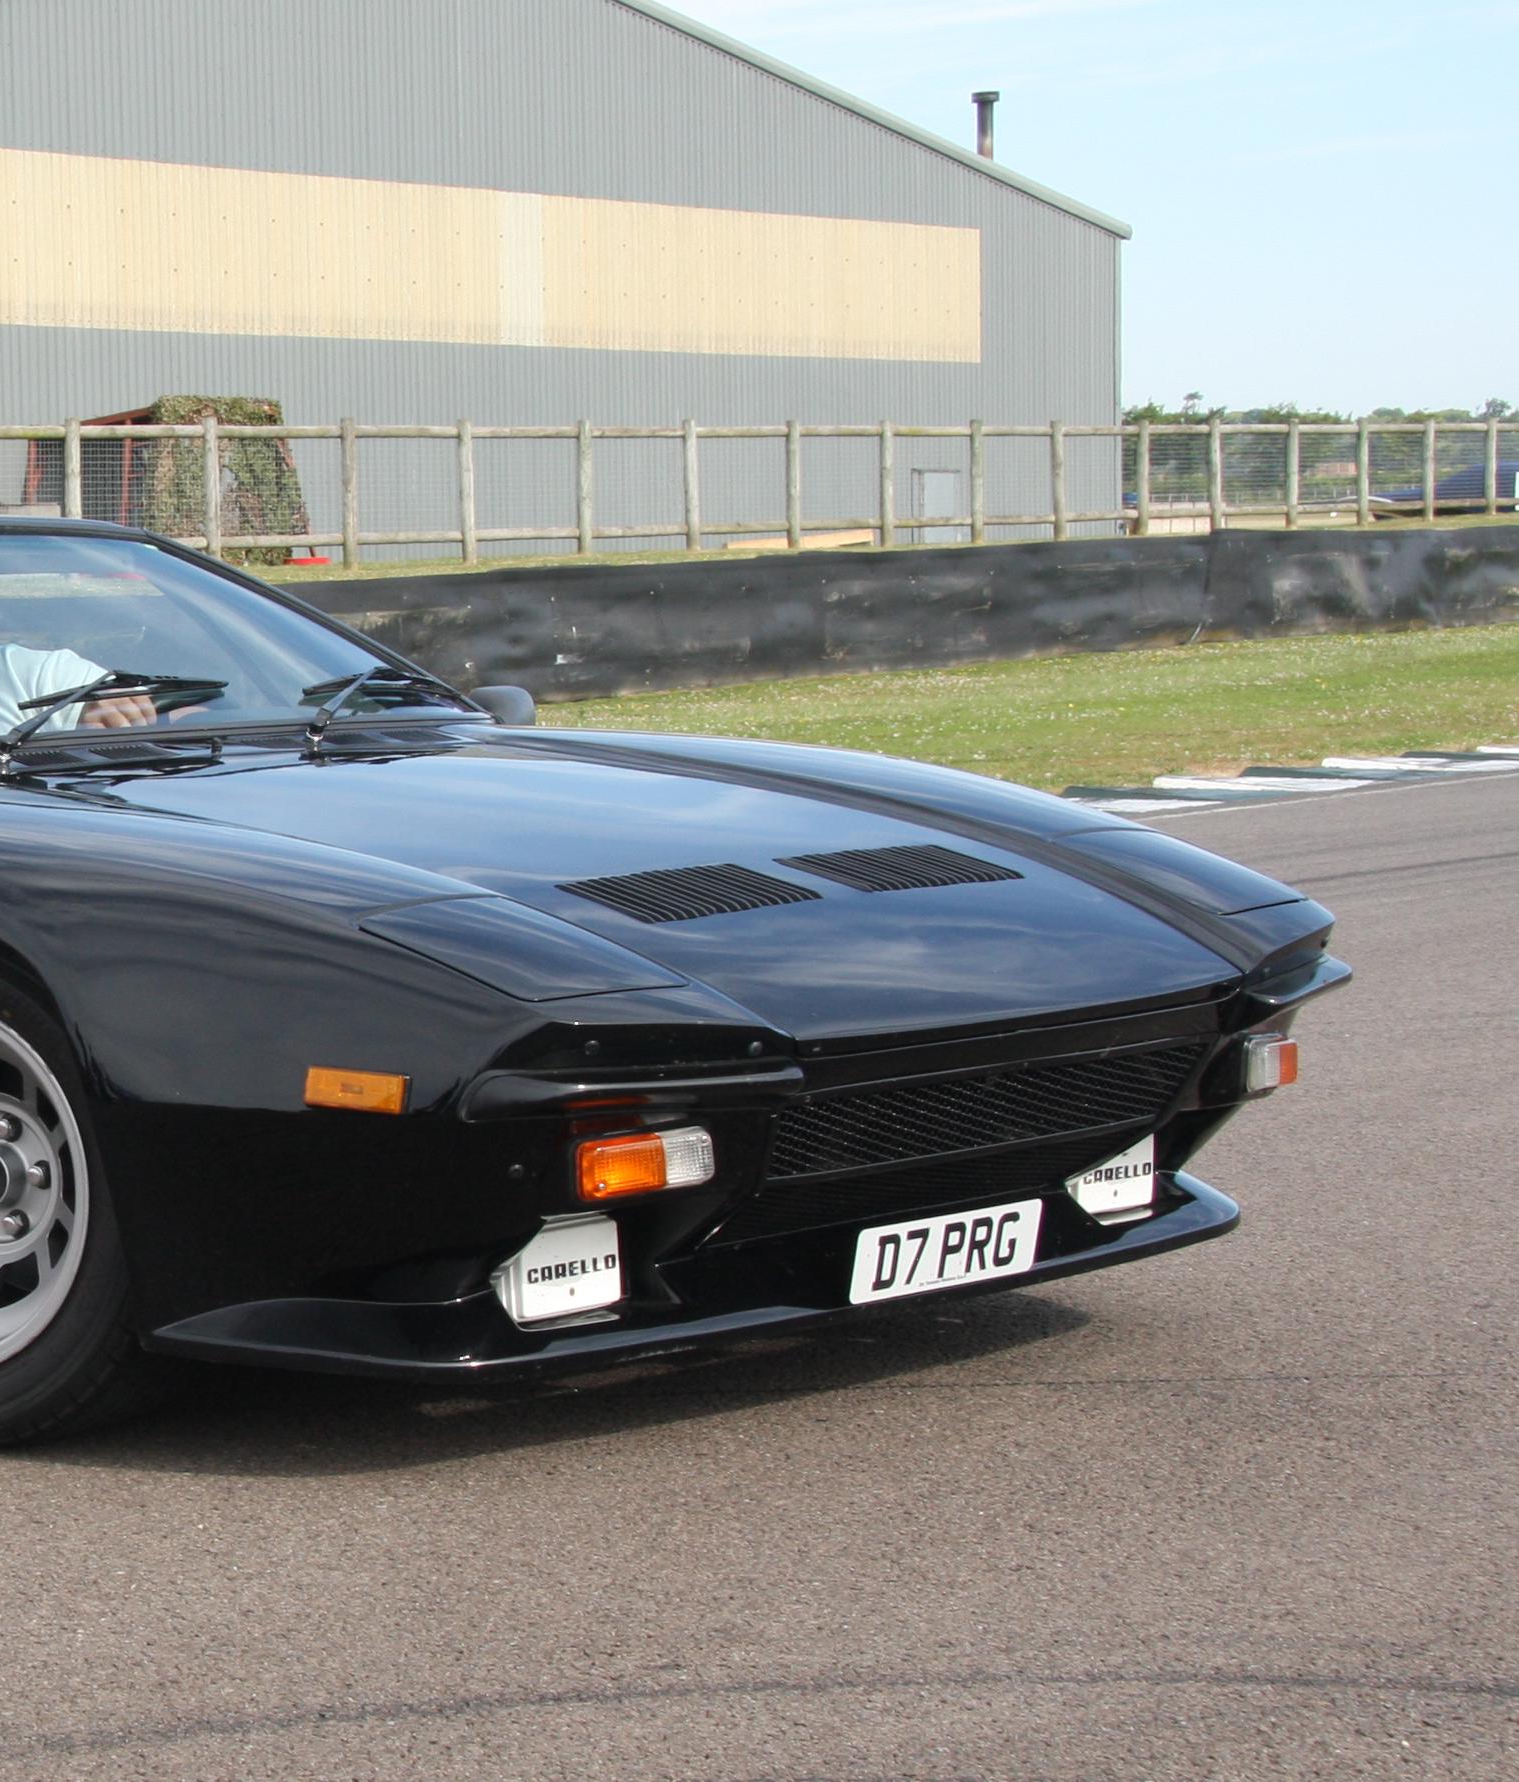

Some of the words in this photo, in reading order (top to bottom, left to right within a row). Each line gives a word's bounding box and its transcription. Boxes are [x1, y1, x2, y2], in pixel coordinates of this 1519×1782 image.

[527, 1254, 617, 1284] CARELLO
[871, 1227, 930, 1292] D7
[937, 1211, 1020, 1278] PRG
